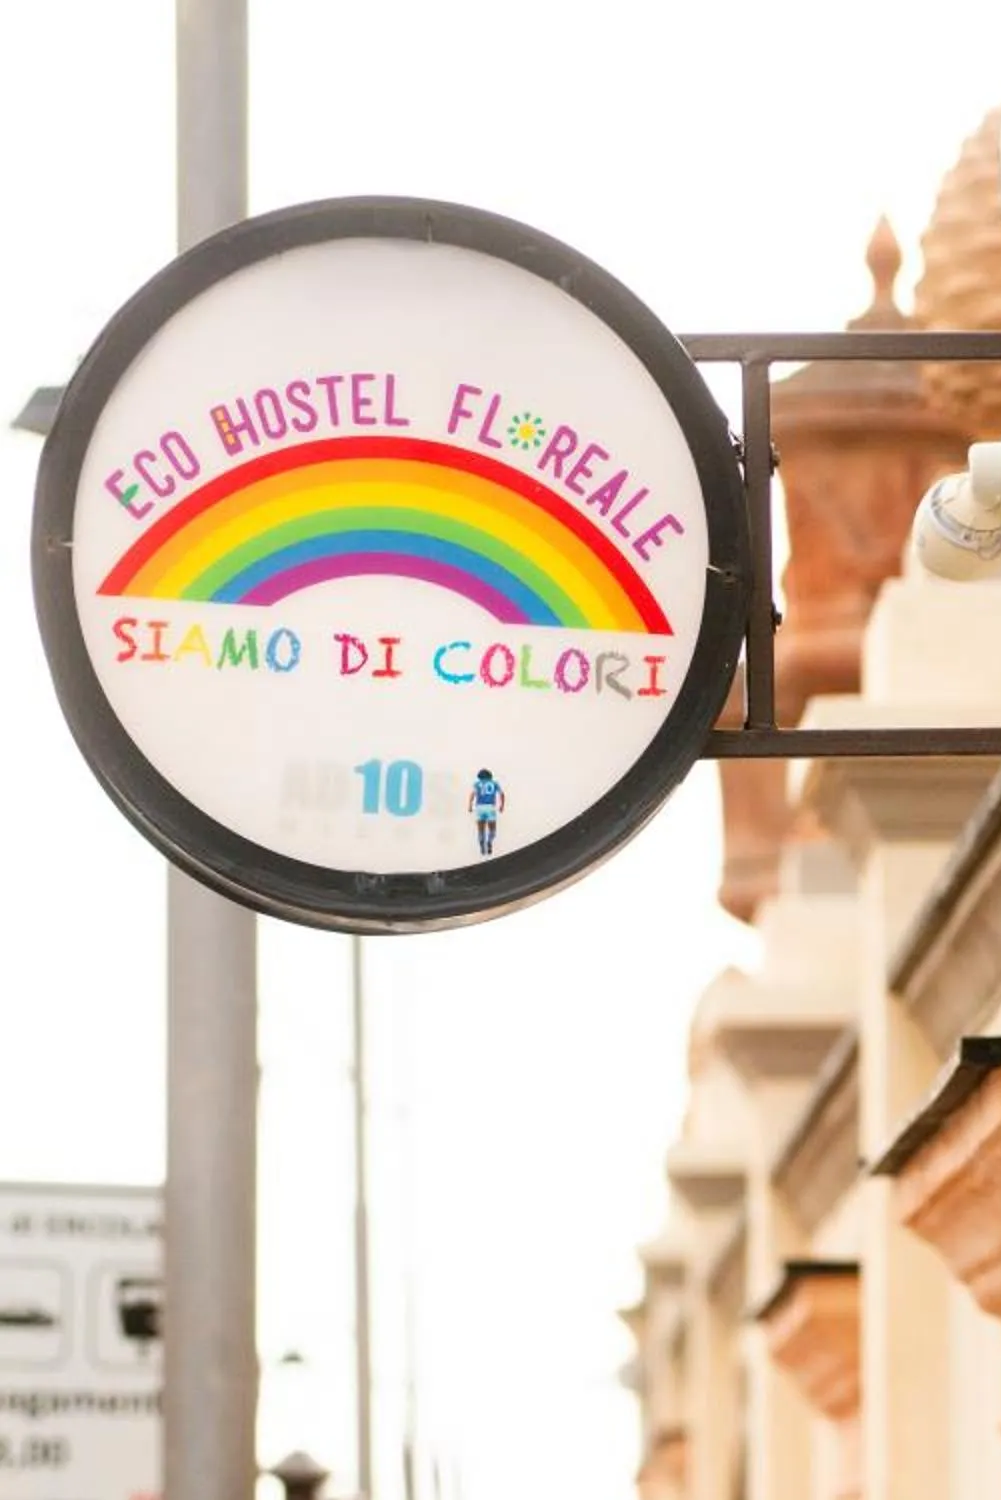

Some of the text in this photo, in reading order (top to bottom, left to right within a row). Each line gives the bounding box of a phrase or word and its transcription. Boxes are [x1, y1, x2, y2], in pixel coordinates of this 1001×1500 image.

[104, 430, 200, 521] ECO
[210, 373, 410, 457] HOSTEL
[115, 617, 668, 700] SIAMO DI COLORI
